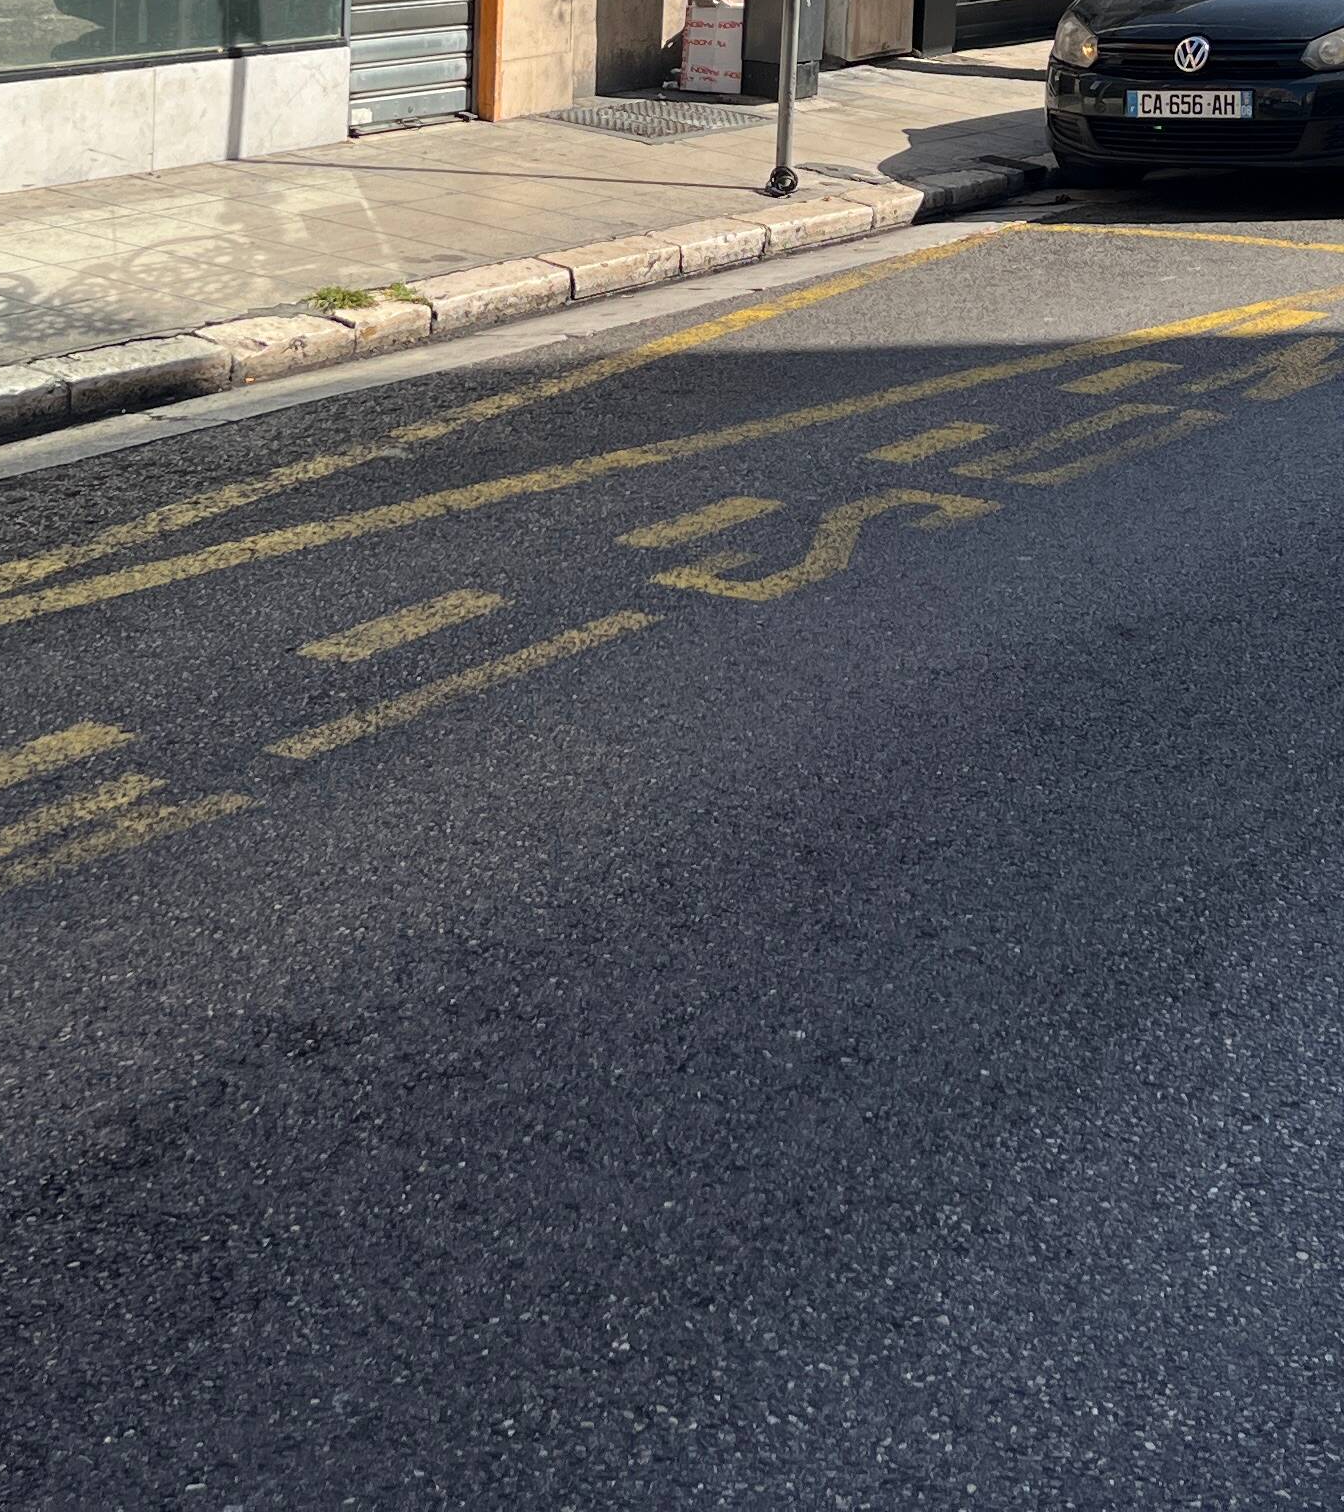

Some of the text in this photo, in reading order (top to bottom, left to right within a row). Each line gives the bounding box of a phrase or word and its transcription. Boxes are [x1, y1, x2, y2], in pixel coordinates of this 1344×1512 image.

[1141, 94, 1163, 115] CA
[1169, 94, 1203, 115] 656
[1212, 94, 1236, 115] AH
